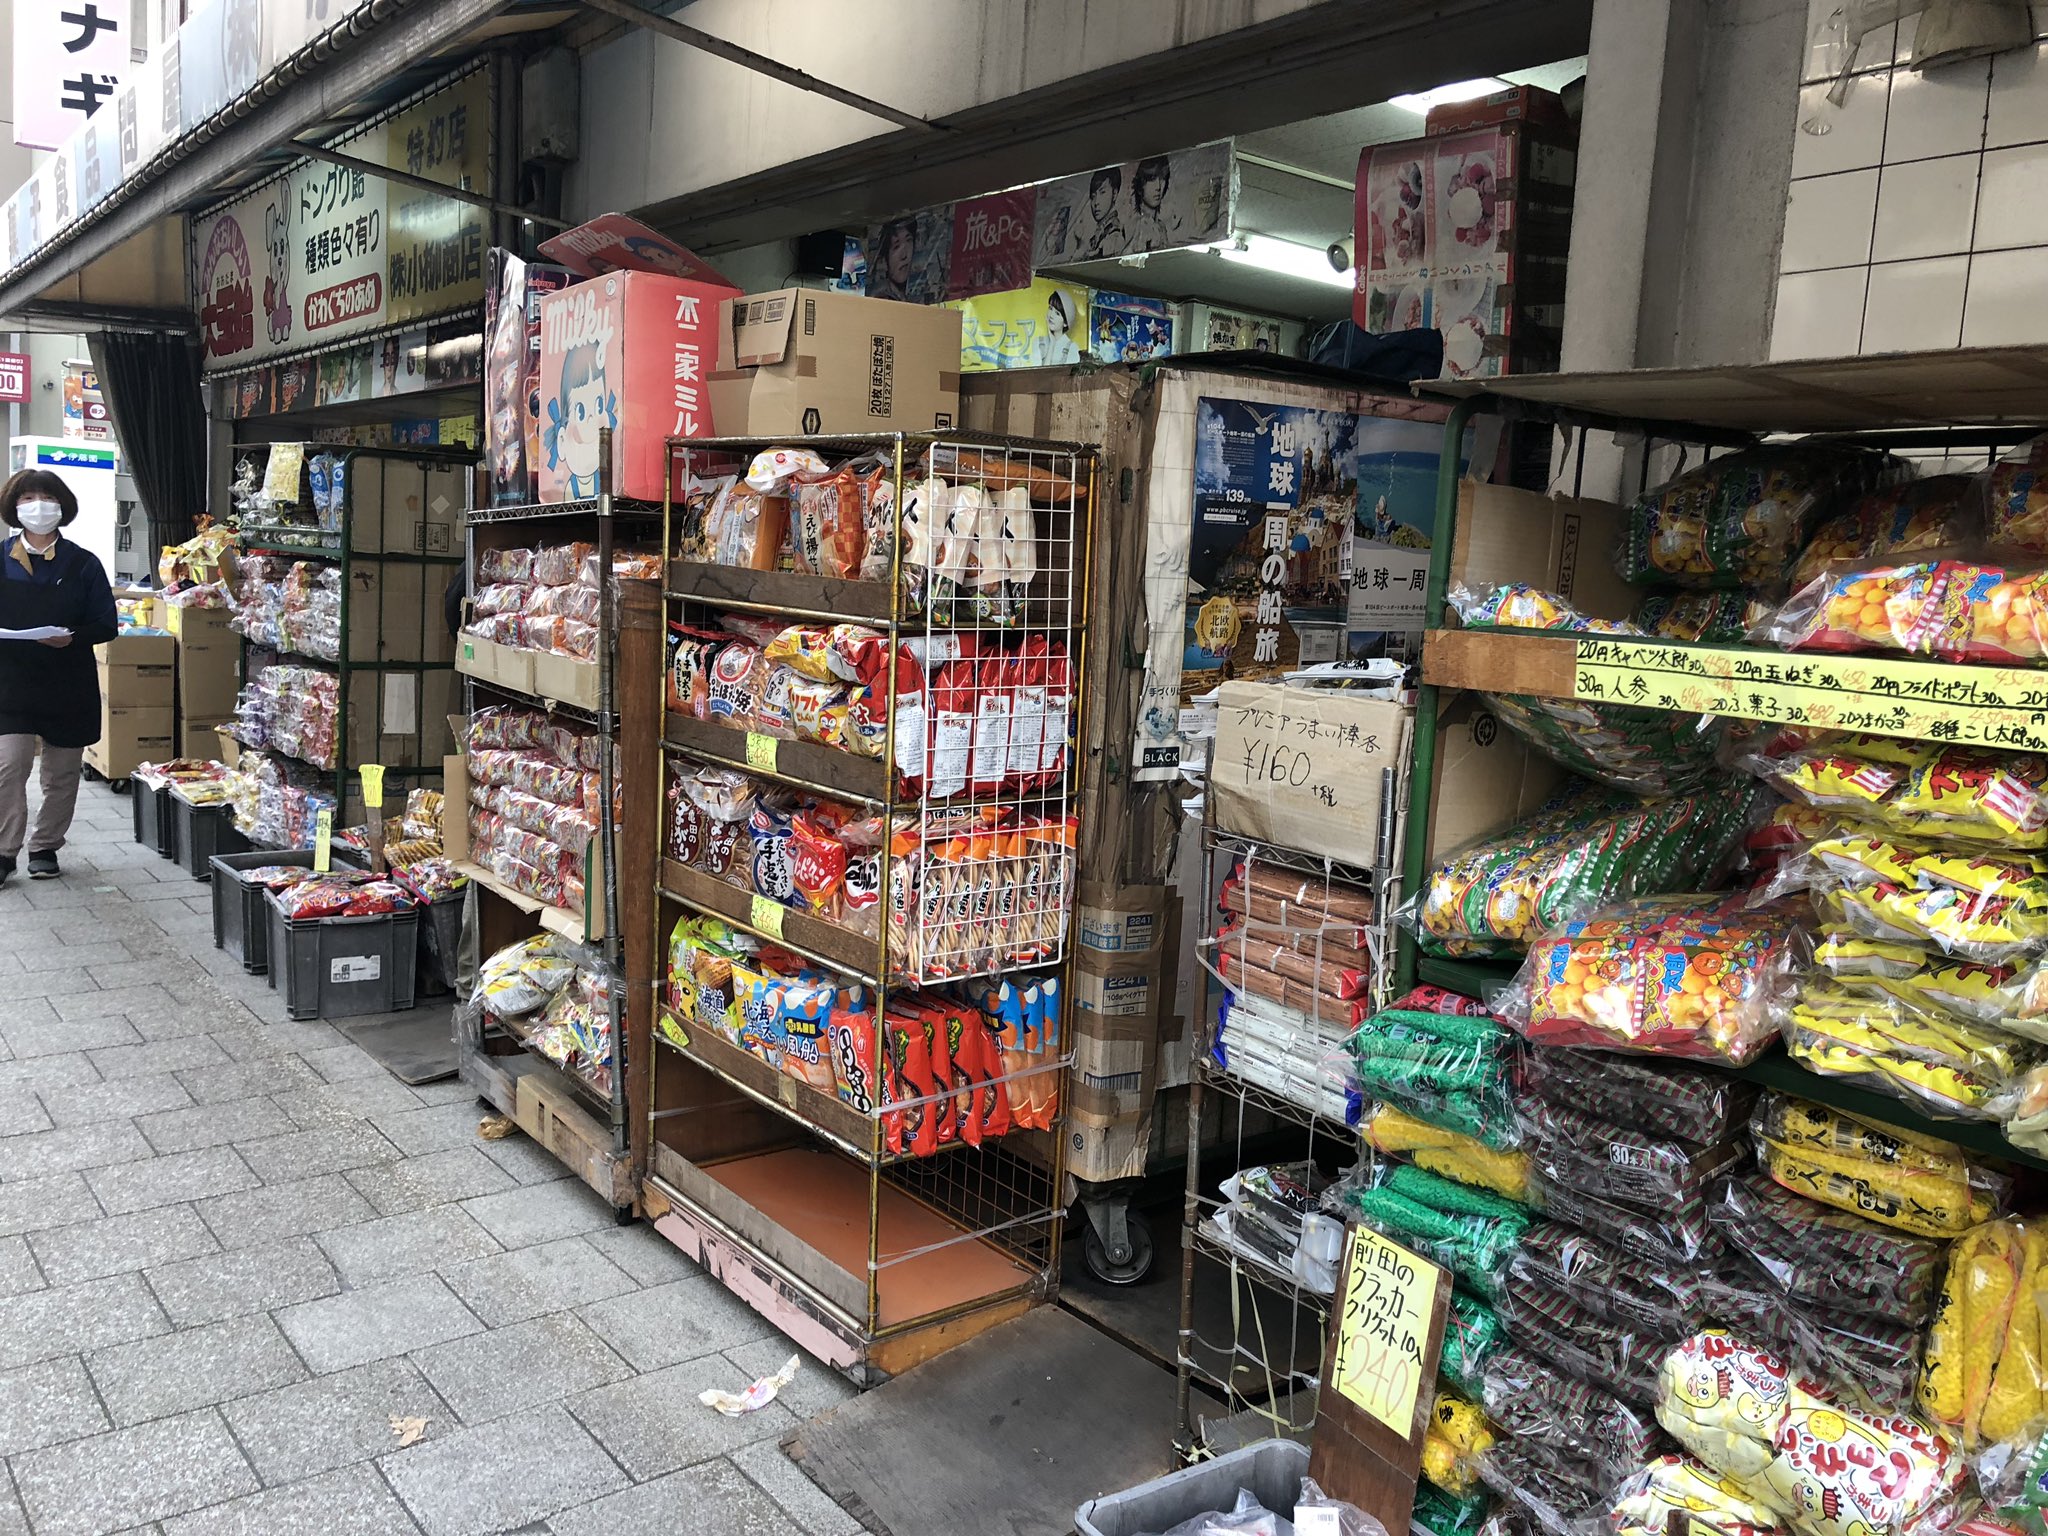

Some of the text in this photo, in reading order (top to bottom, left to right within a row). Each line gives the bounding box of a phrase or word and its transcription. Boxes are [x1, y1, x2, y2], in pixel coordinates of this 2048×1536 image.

[407, 104, 466, 175] 特約店
[305, 209, 380, 275] 種類色々有り
[308, 279, 376, 327] かわぐちのあめ
[546, 289, 614, 370] Milky
[871, 388, 883, 414] 20枚
[1253, 422, 1296, 662] 地球一周の船旅
[1352, 567, 1426, 591] 地球一周
[1210, 614, 1229, 626] 北欧
[1143, 753, 1178, 763] BLACK
[1242, 736, 1311, 787] ¥160
[760, 838, 784, 899] 手塩屋
[772, 1034, 820, 1065] い風船
[1355, 1231, 1415, 1287] 前田の
[1350, 1266, 1419, 1320] クラッカー
